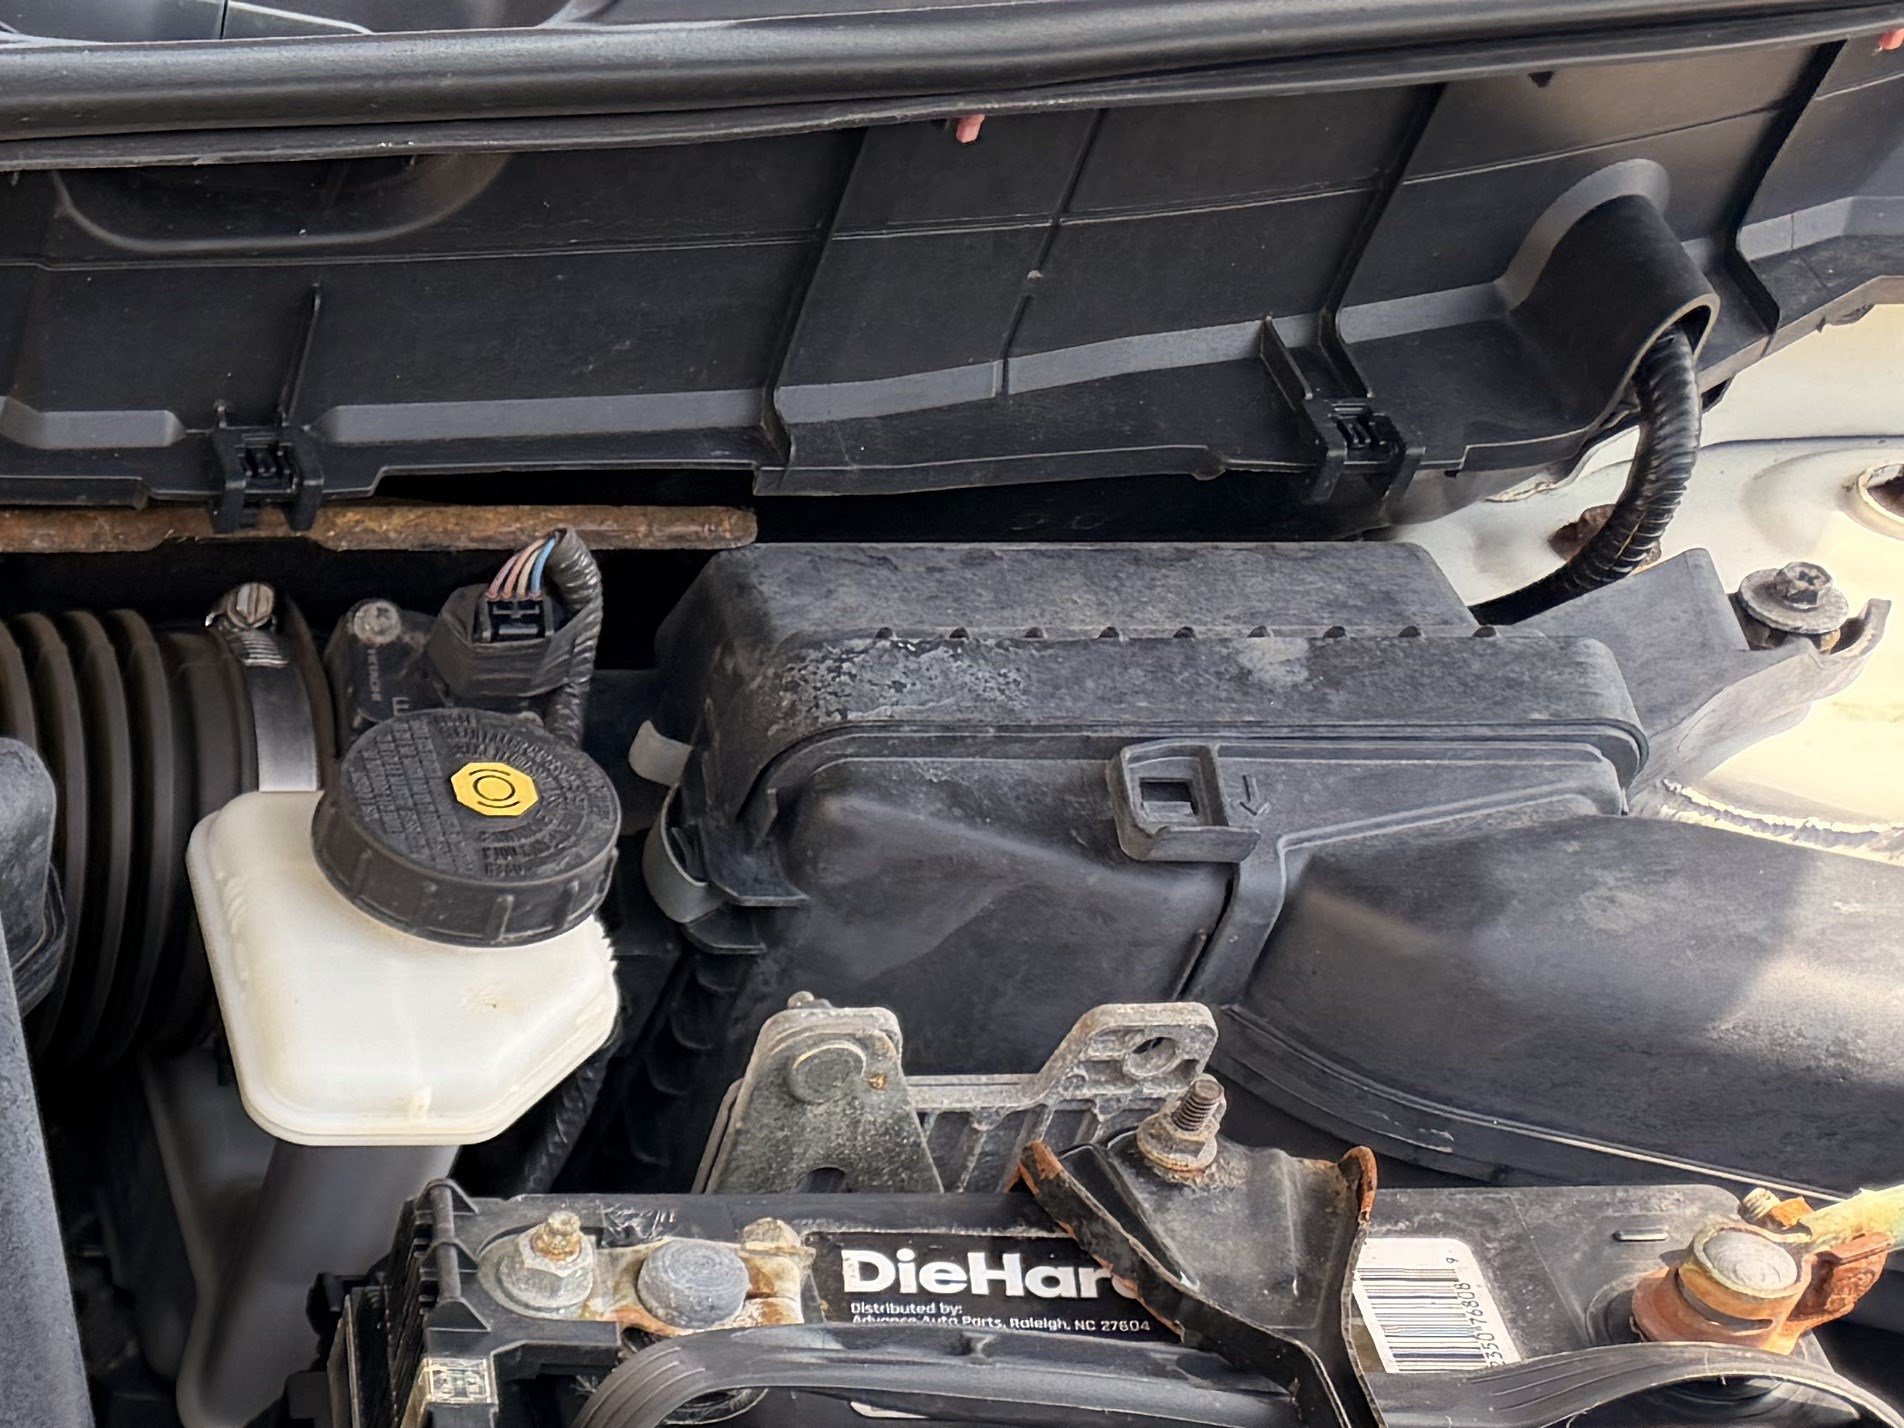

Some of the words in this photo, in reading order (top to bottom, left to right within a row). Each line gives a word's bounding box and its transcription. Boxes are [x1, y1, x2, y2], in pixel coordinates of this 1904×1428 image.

[1445, 1256, 1460, 1264] 9
[850, 1302, 936, 1317] Distributed
[939, 1302, 963, 1317] by:
[1454, 1282, 1487, 1326] 76808
[962, 1316, 1008, 1331] Parts,
[1074, 1319, 1096, 1332] NC
[1100, 1320, 1151, 1332] 27604
